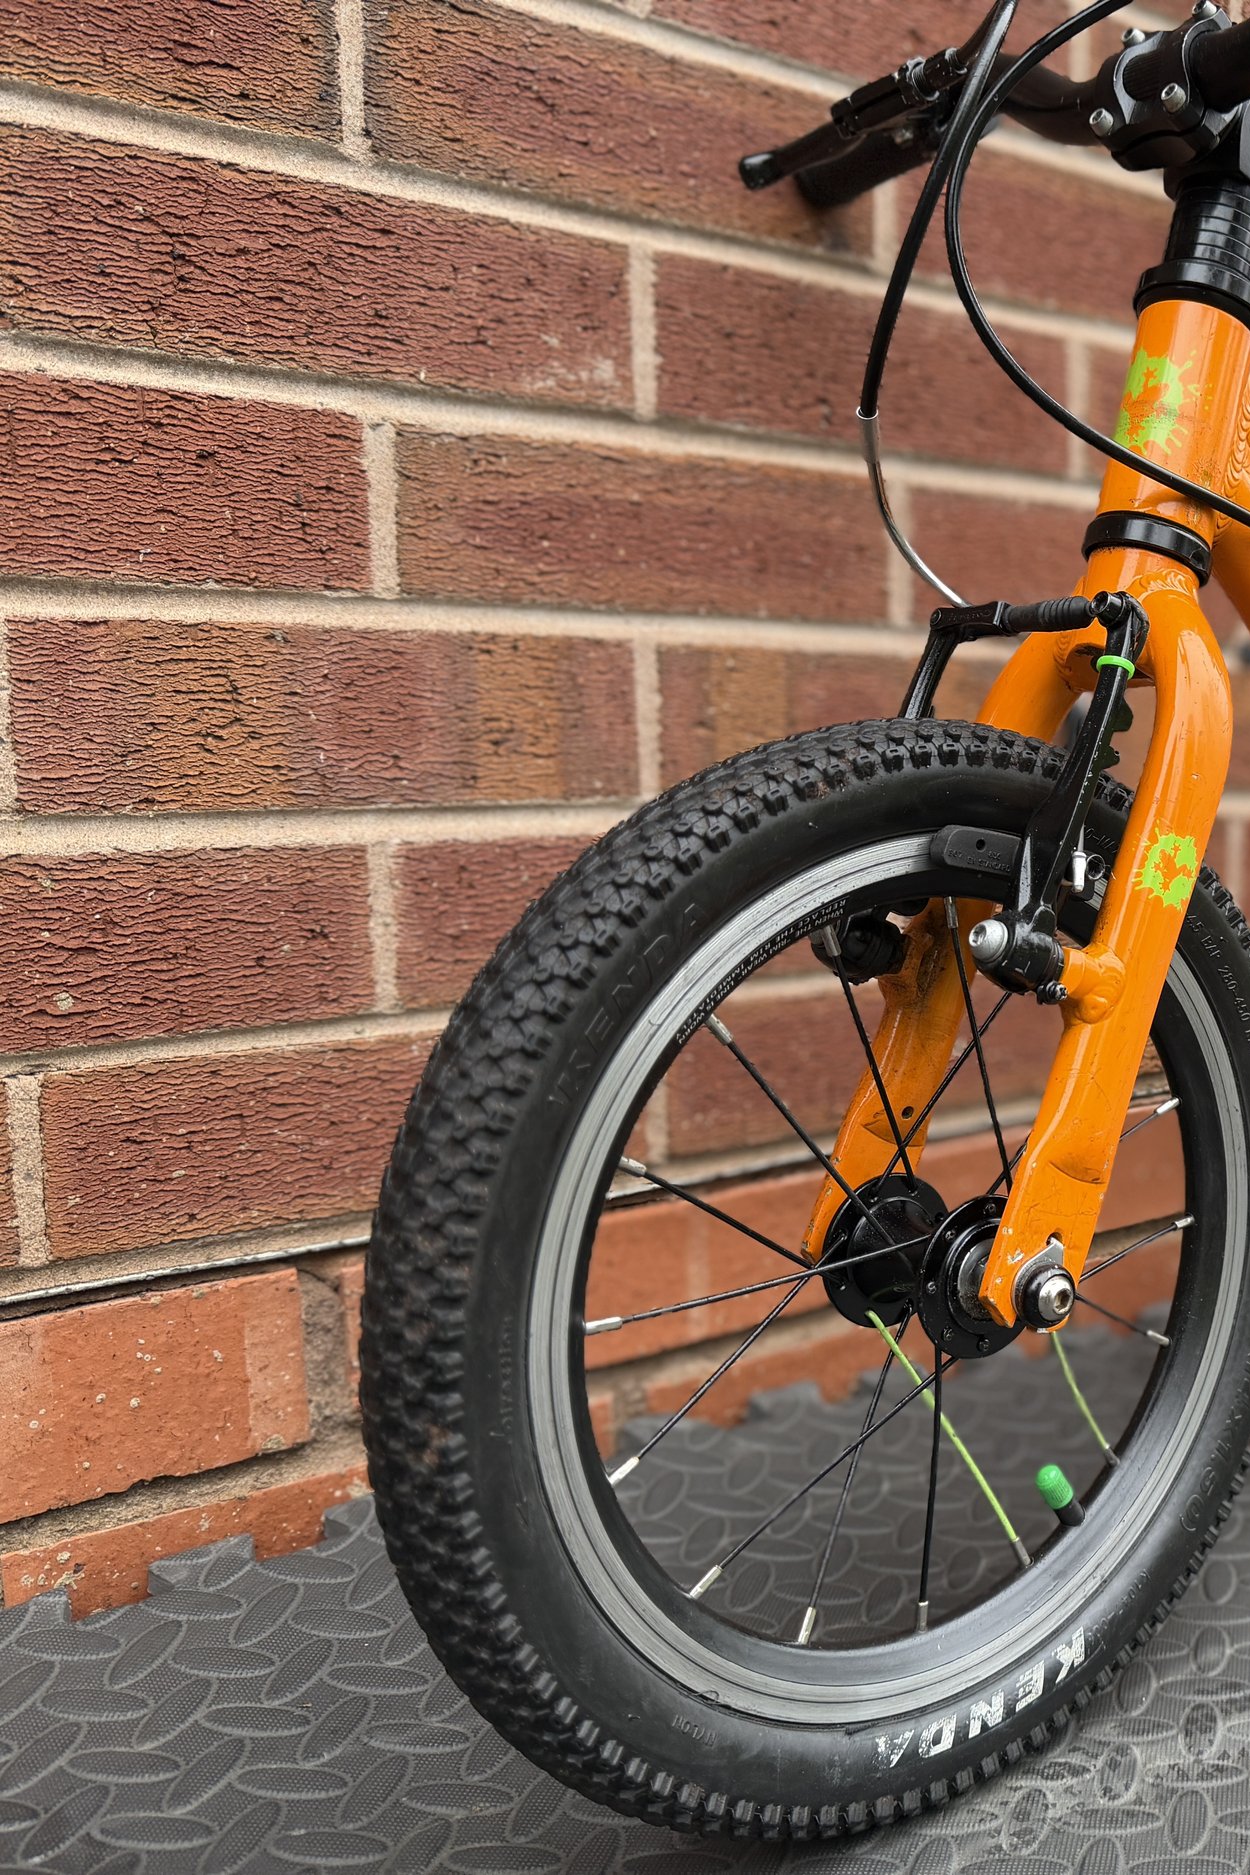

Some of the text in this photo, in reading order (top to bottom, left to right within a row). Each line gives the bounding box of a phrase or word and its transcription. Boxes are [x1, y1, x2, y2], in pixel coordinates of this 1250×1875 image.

[795, 923, 813, 938] THE
[815, 908, 844, 926] WHEN
[676, 898, 847, 1041] REPLACE THE RIM IMMEDIATELY
[1201, 935, 1221, 958] BAR
[1217, 965, 1250, 1021] 280-450
[553, 901, 715, 1103] KENDA
[706, 1000, 715, 1011] IS
[715, 981, 735, 1001] LINE
[678, 1012, 706, 1045] WORN
[874, 1625, 1086, 1769] KENDA
